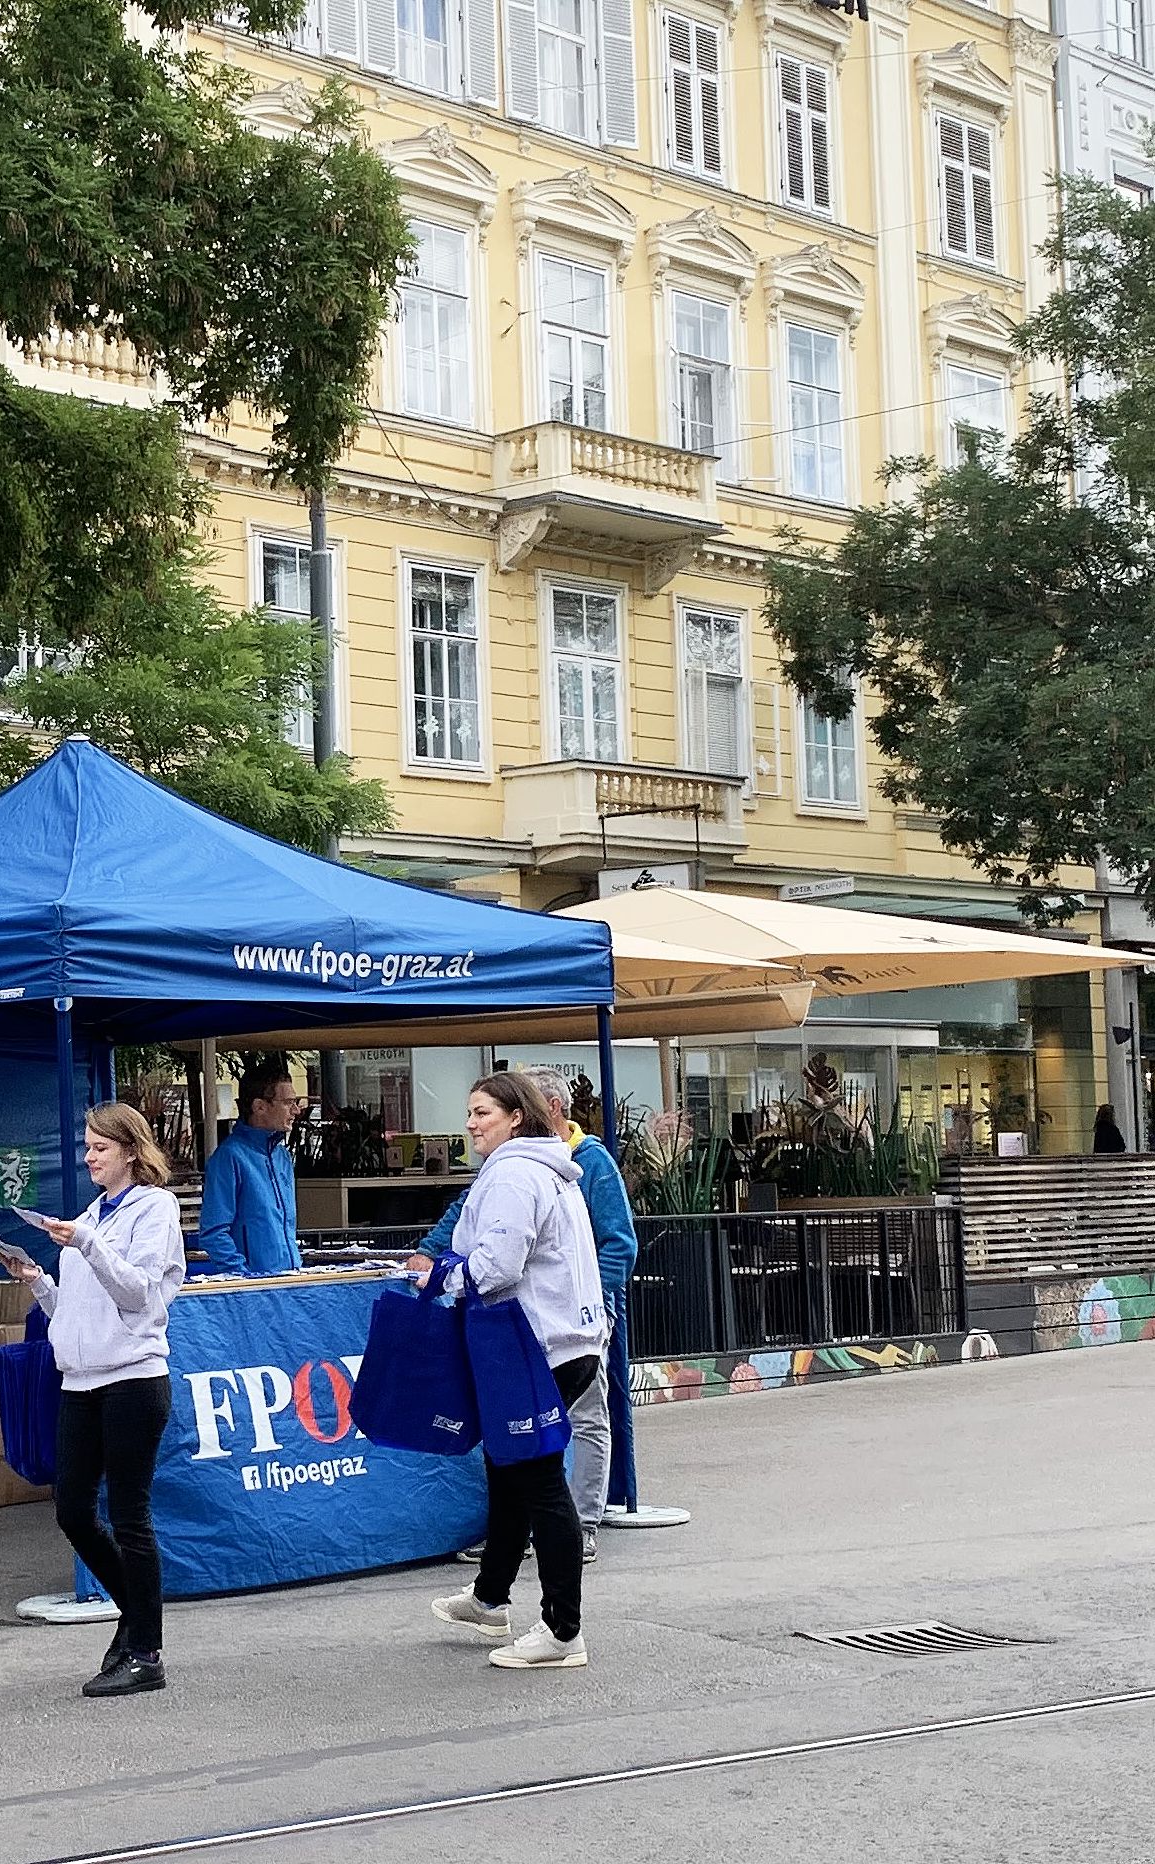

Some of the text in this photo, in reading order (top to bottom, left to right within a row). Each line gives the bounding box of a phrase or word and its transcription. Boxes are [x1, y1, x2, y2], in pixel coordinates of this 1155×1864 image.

[233, 941, 475, 986] www.fpoe-graz.at
[359, 1050, 405, 1061] NEUROTH
[266, 1455, 368, 1492] /fpoegraz
